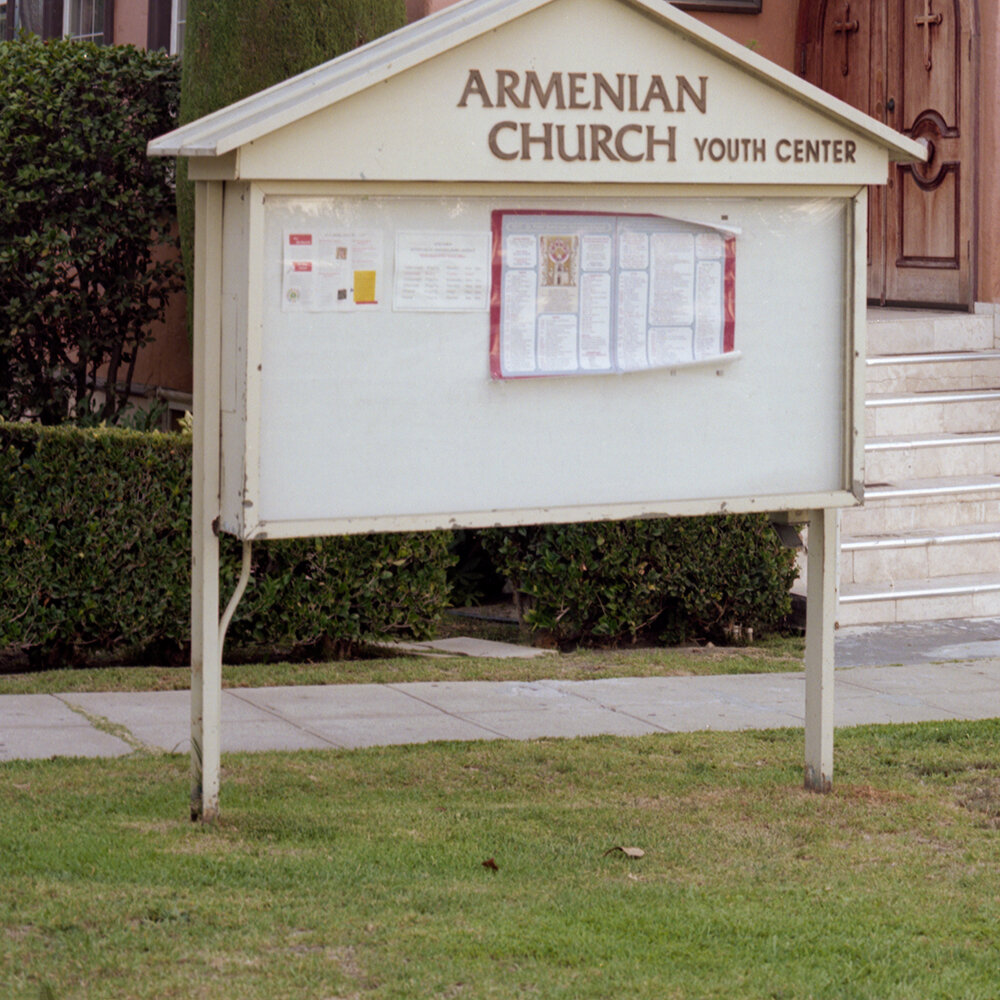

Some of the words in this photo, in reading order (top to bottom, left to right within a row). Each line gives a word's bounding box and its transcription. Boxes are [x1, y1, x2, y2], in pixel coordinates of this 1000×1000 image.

[456, 69, 709, 114] ARMENIAN
[488, 120, 677, 162] CHURCH
[694, 137, 767, 162] YOUTH
[775, 138, 857, 163] CENTER
